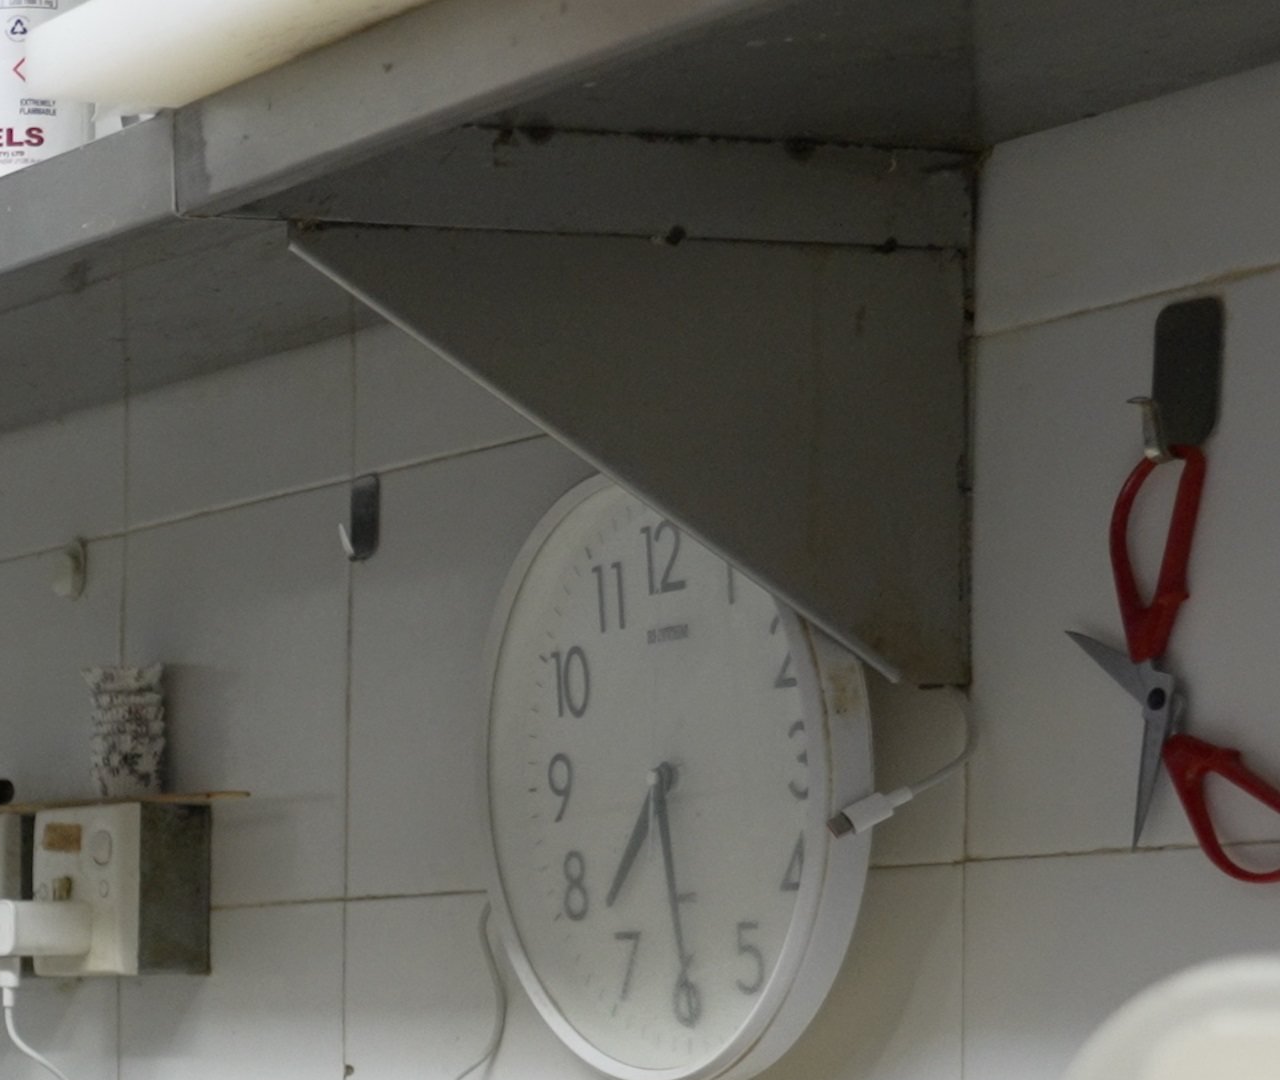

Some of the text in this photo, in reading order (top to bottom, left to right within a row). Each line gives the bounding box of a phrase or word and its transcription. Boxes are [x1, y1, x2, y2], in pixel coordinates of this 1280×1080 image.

[640, 519, 687, 596] 12
[591, 561, 627, 634] 11
[550, 645, 591, 719] 10
[548, 753, 573, 823] 9
[563, 850, 589, 922] 8
[614, 930, 643, 1003] 7
[735, 920, 766, 996] 5
